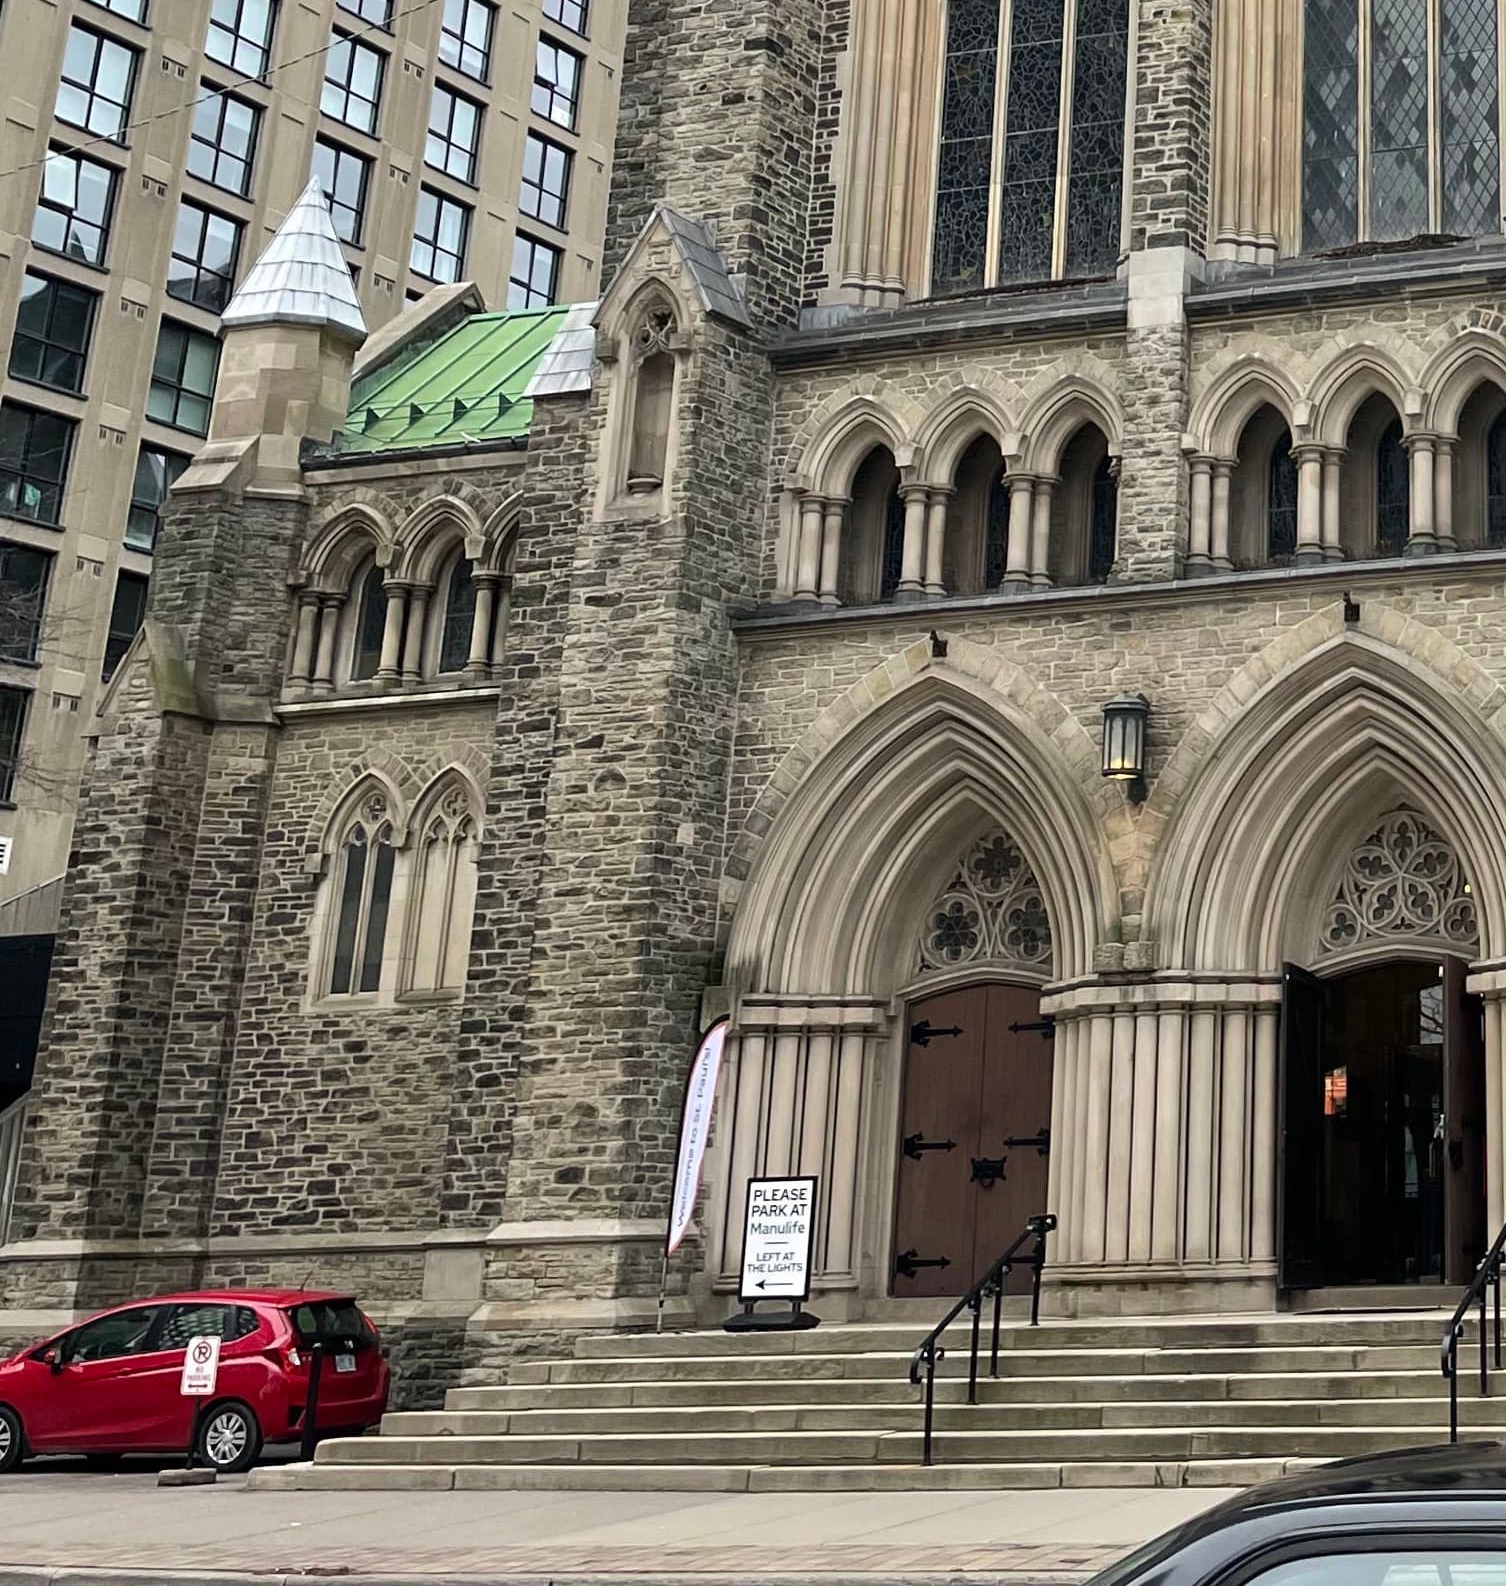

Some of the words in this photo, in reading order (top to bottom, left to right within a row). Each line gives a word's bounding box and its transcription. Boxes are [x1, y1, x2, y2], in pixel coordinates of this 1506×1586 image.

[753, 1188, 808, 1202] PLEASE
[751, 1204, 788, 1217] PARK
[790, 1203, 808, 1216] AT
[750, 1220, 806, 1235] Manulife
[756, 1252, 782, 1262] LEFT
[782, 1252, 796, 1261] AT
[747, 1263, 765, 1273] THE
[767, 1262, 803, 1273] LIGHTS
